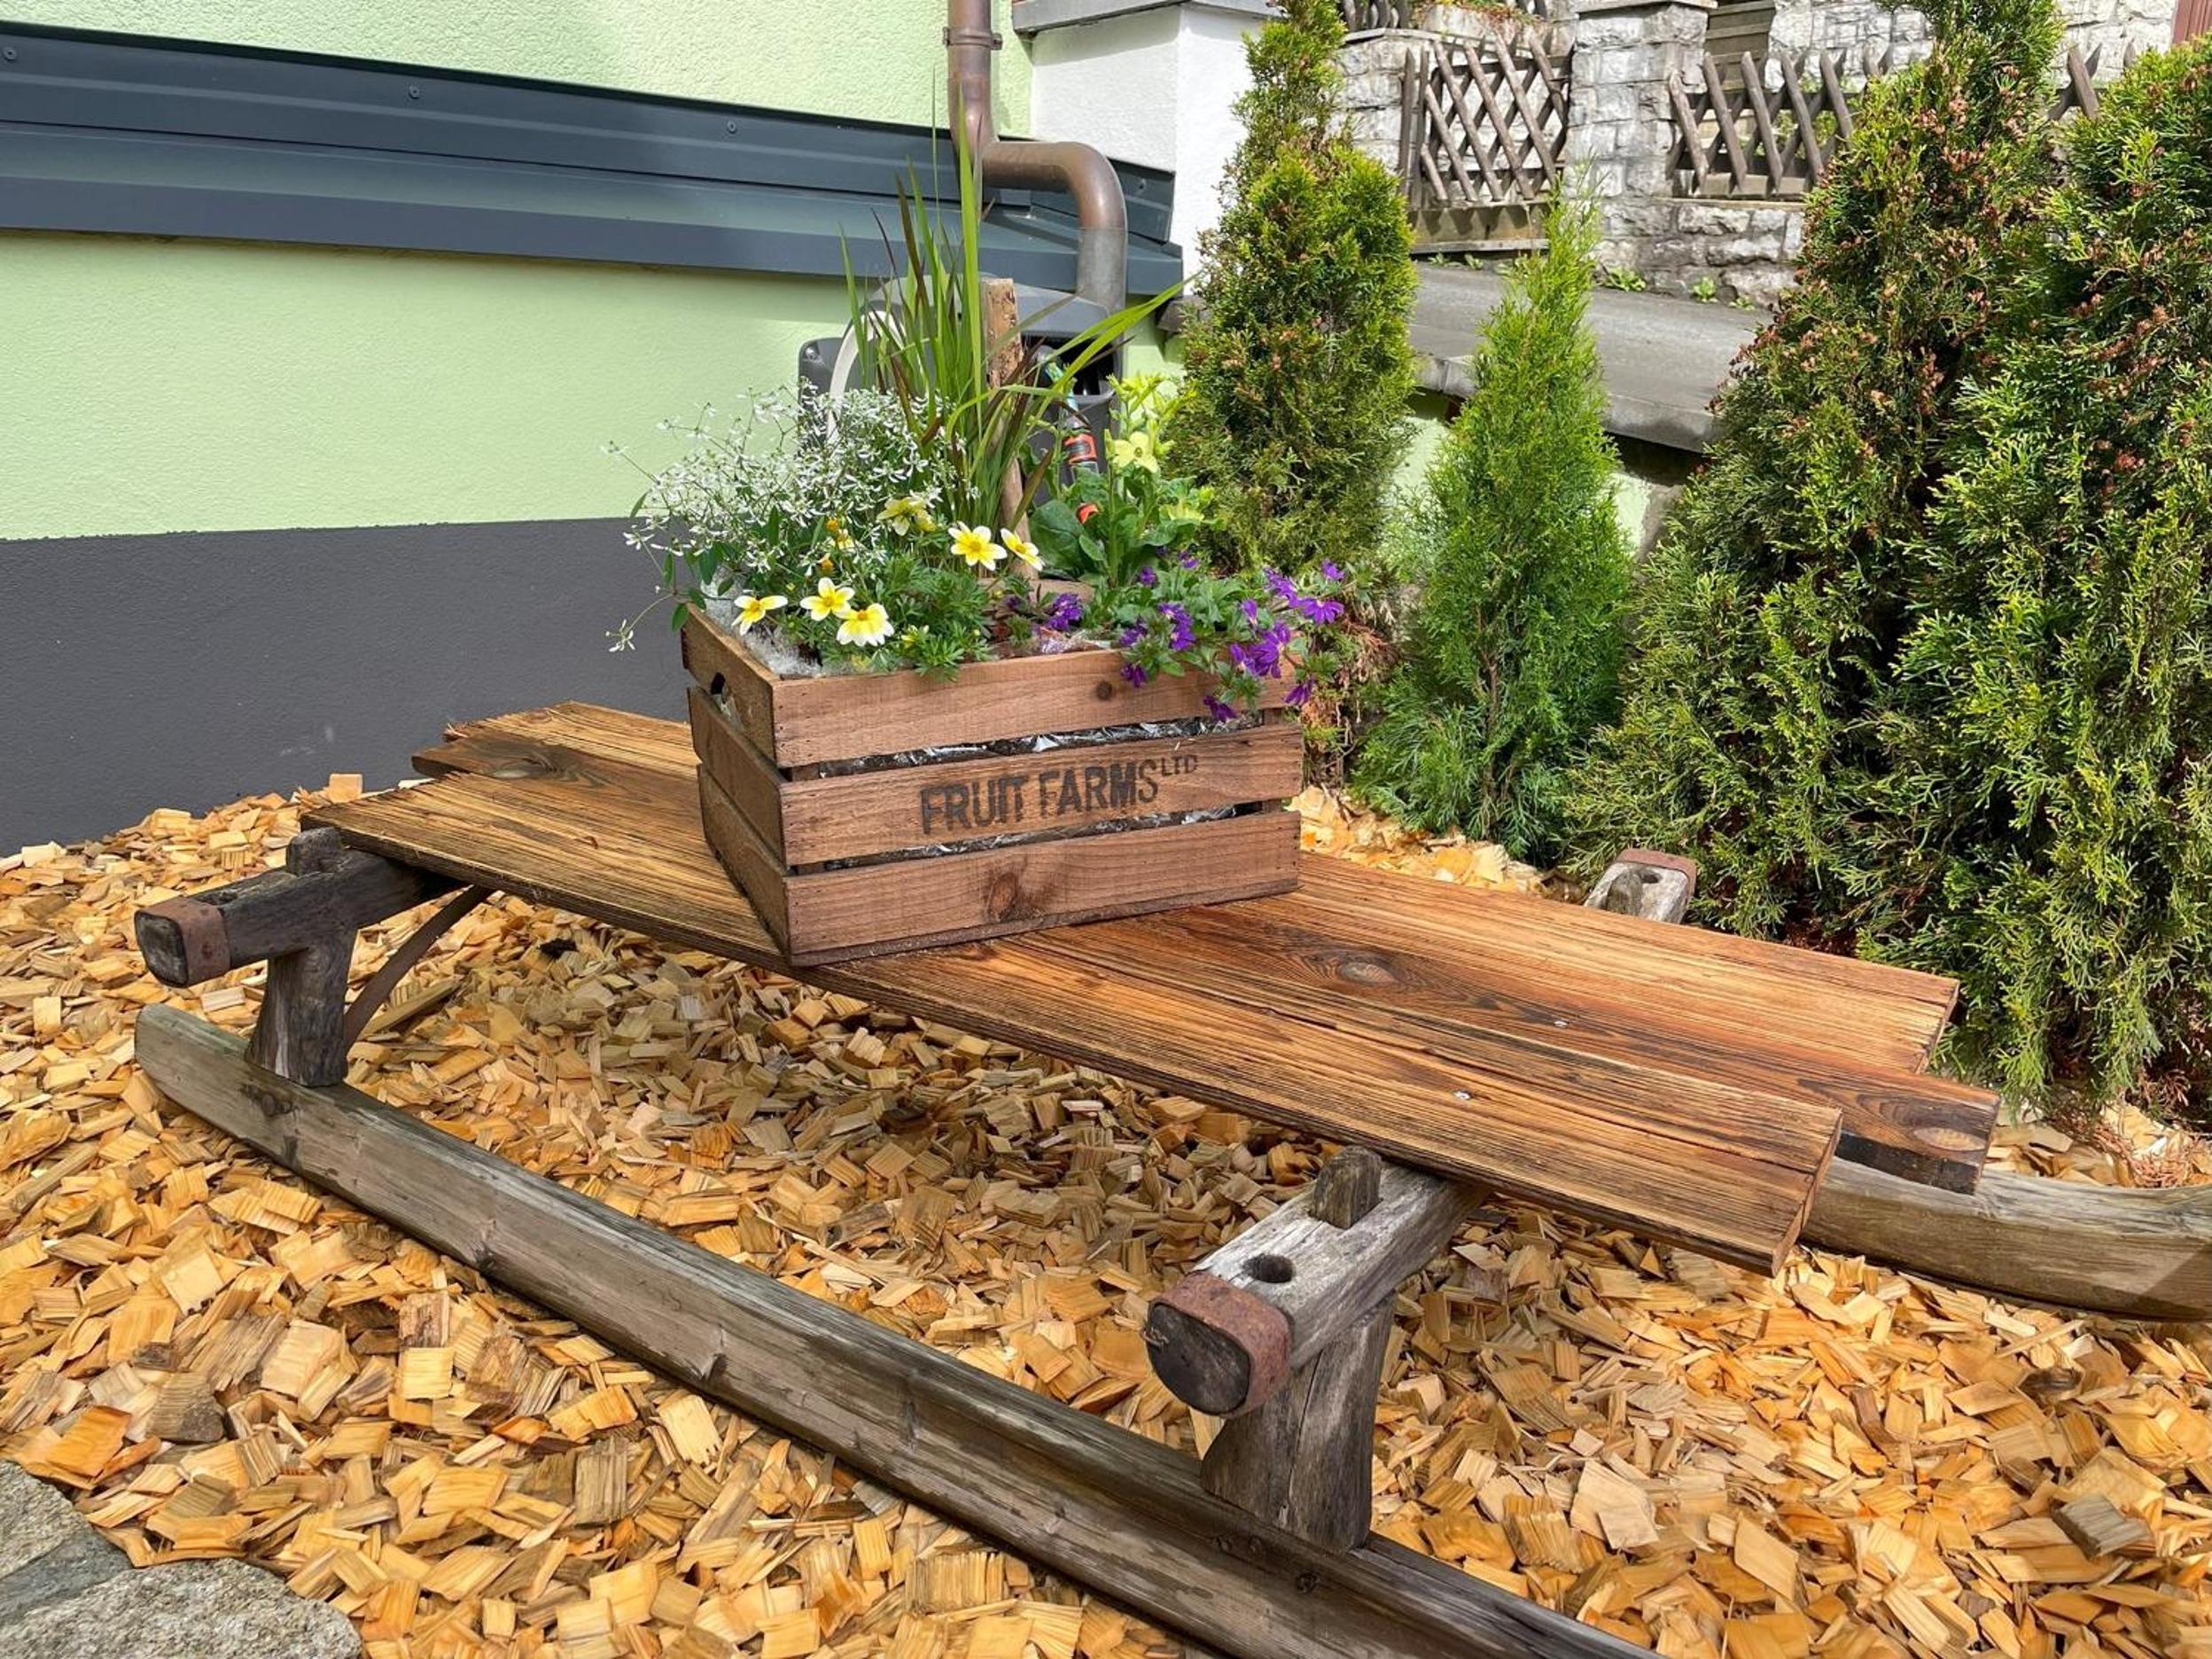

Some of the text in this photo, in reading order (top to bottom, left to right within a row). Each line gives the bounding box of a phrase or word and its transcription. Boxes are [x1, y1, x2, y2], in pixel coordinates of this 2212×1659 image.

[920, 754, 1197, 834] FRUIT FARMS LTD
